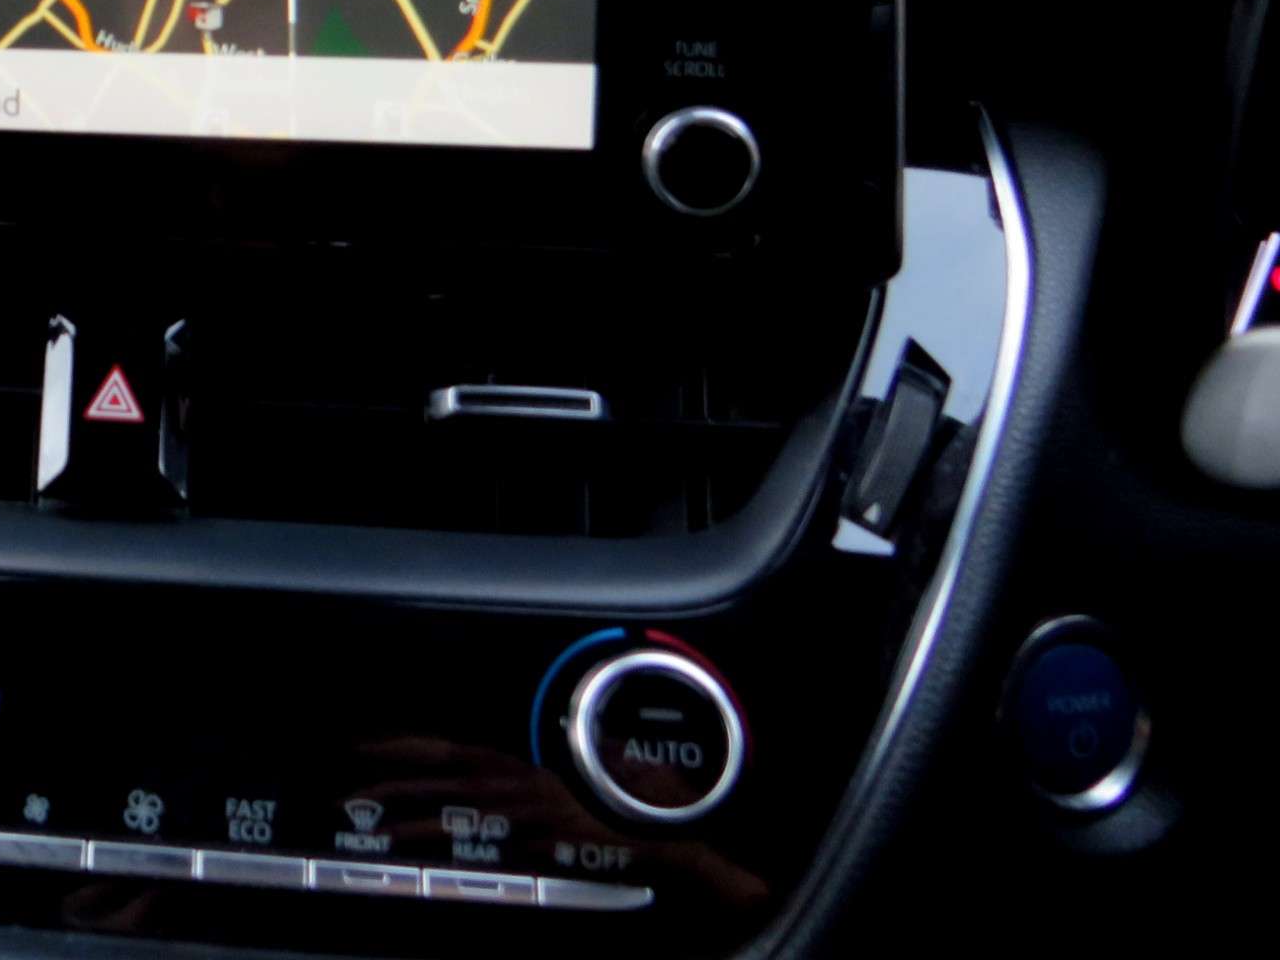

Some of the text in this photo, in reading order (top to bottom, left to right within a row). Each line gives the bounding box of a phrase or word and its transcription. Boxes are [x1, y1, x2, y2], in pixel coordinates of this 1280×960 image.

[676, 41, 718, 58] TUNE
[664, 61, 725, 78] SCROLL
[623, 737, 702, 769] AUTO
[226, 798, 277, 819] FAST
[229, 819, 272, 843] ECO
[335, 830, 391, 854] FRONT
[452, 841, 500, 863] REAR
[580, 844, 632, 871] OFF
